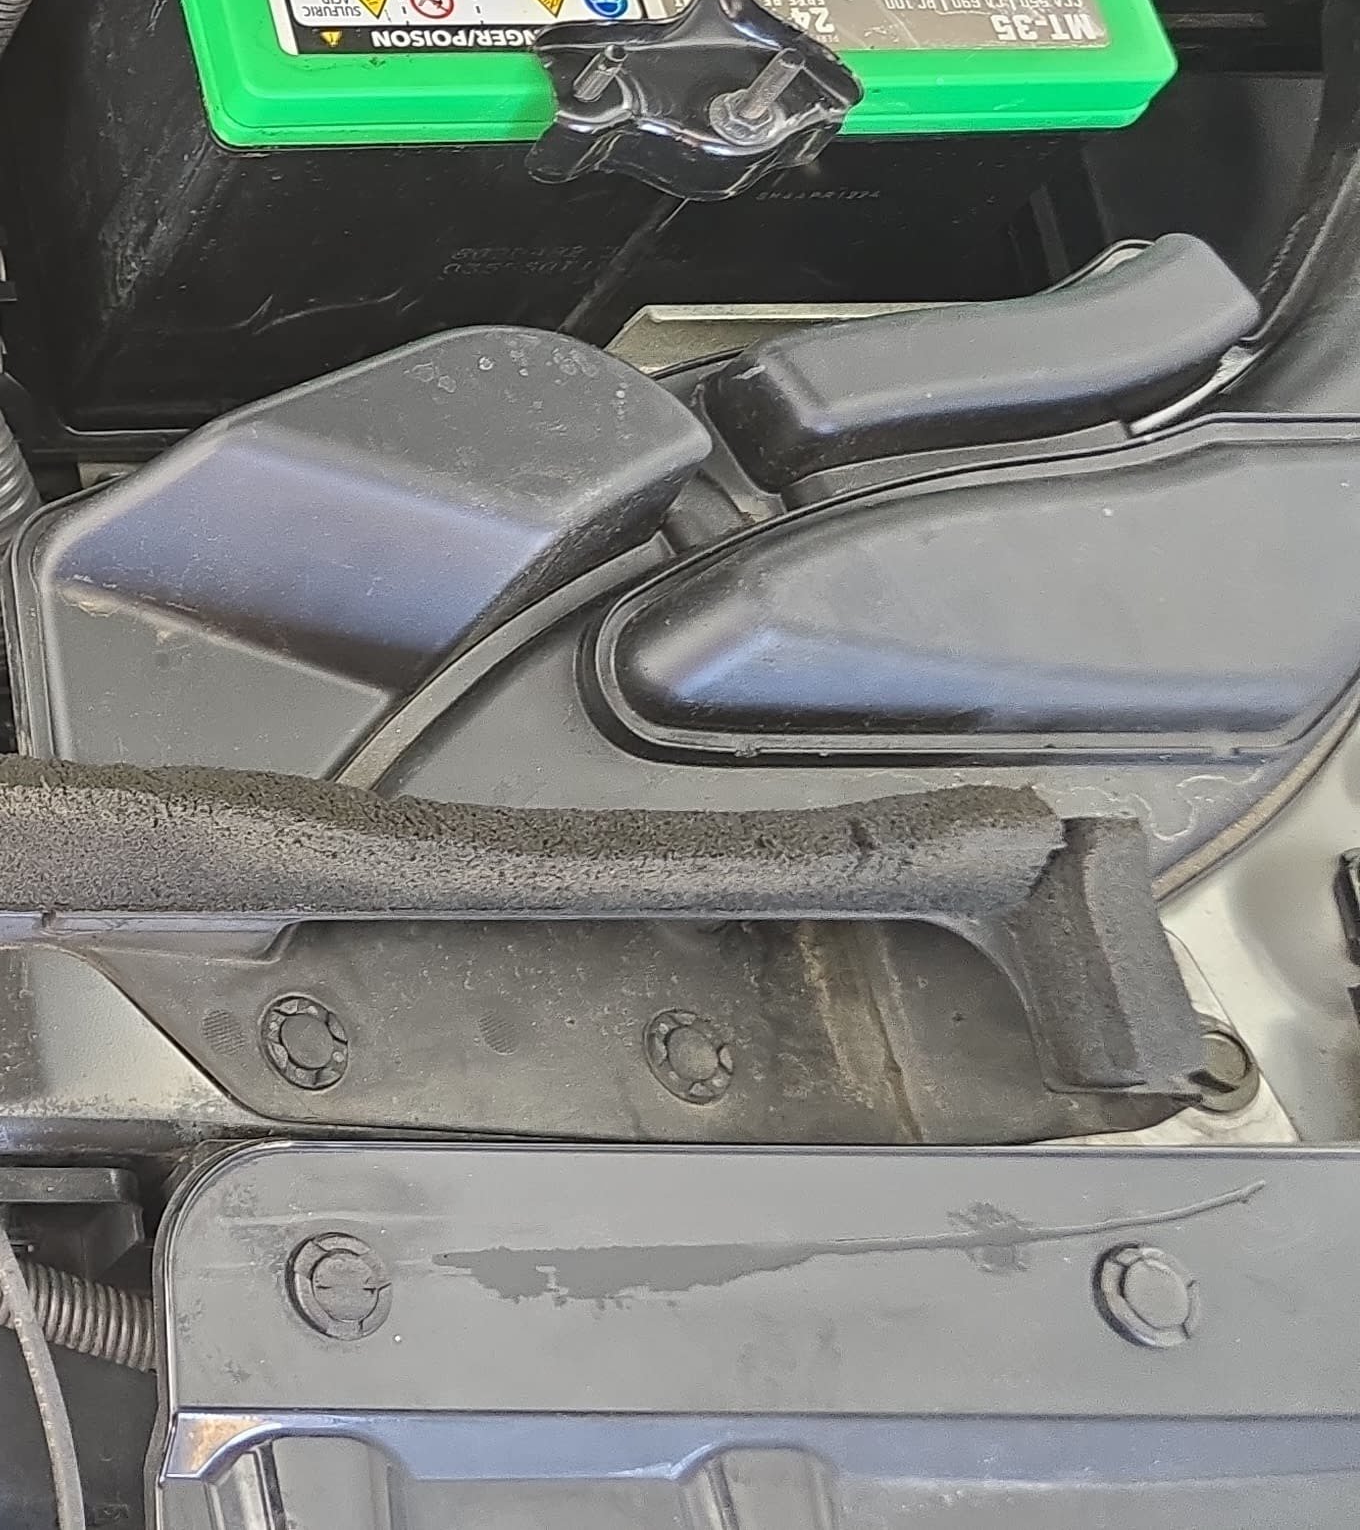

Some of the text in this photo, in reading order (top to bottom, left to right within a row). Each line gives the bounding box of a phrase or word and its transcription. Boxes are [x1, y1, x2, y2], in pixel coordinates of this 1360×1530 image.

[302, 6, 361, 17] SULFURIC
[990, 13, 1096, 40] MT-35
[371, 29, 538, 47] NGER/POISON
